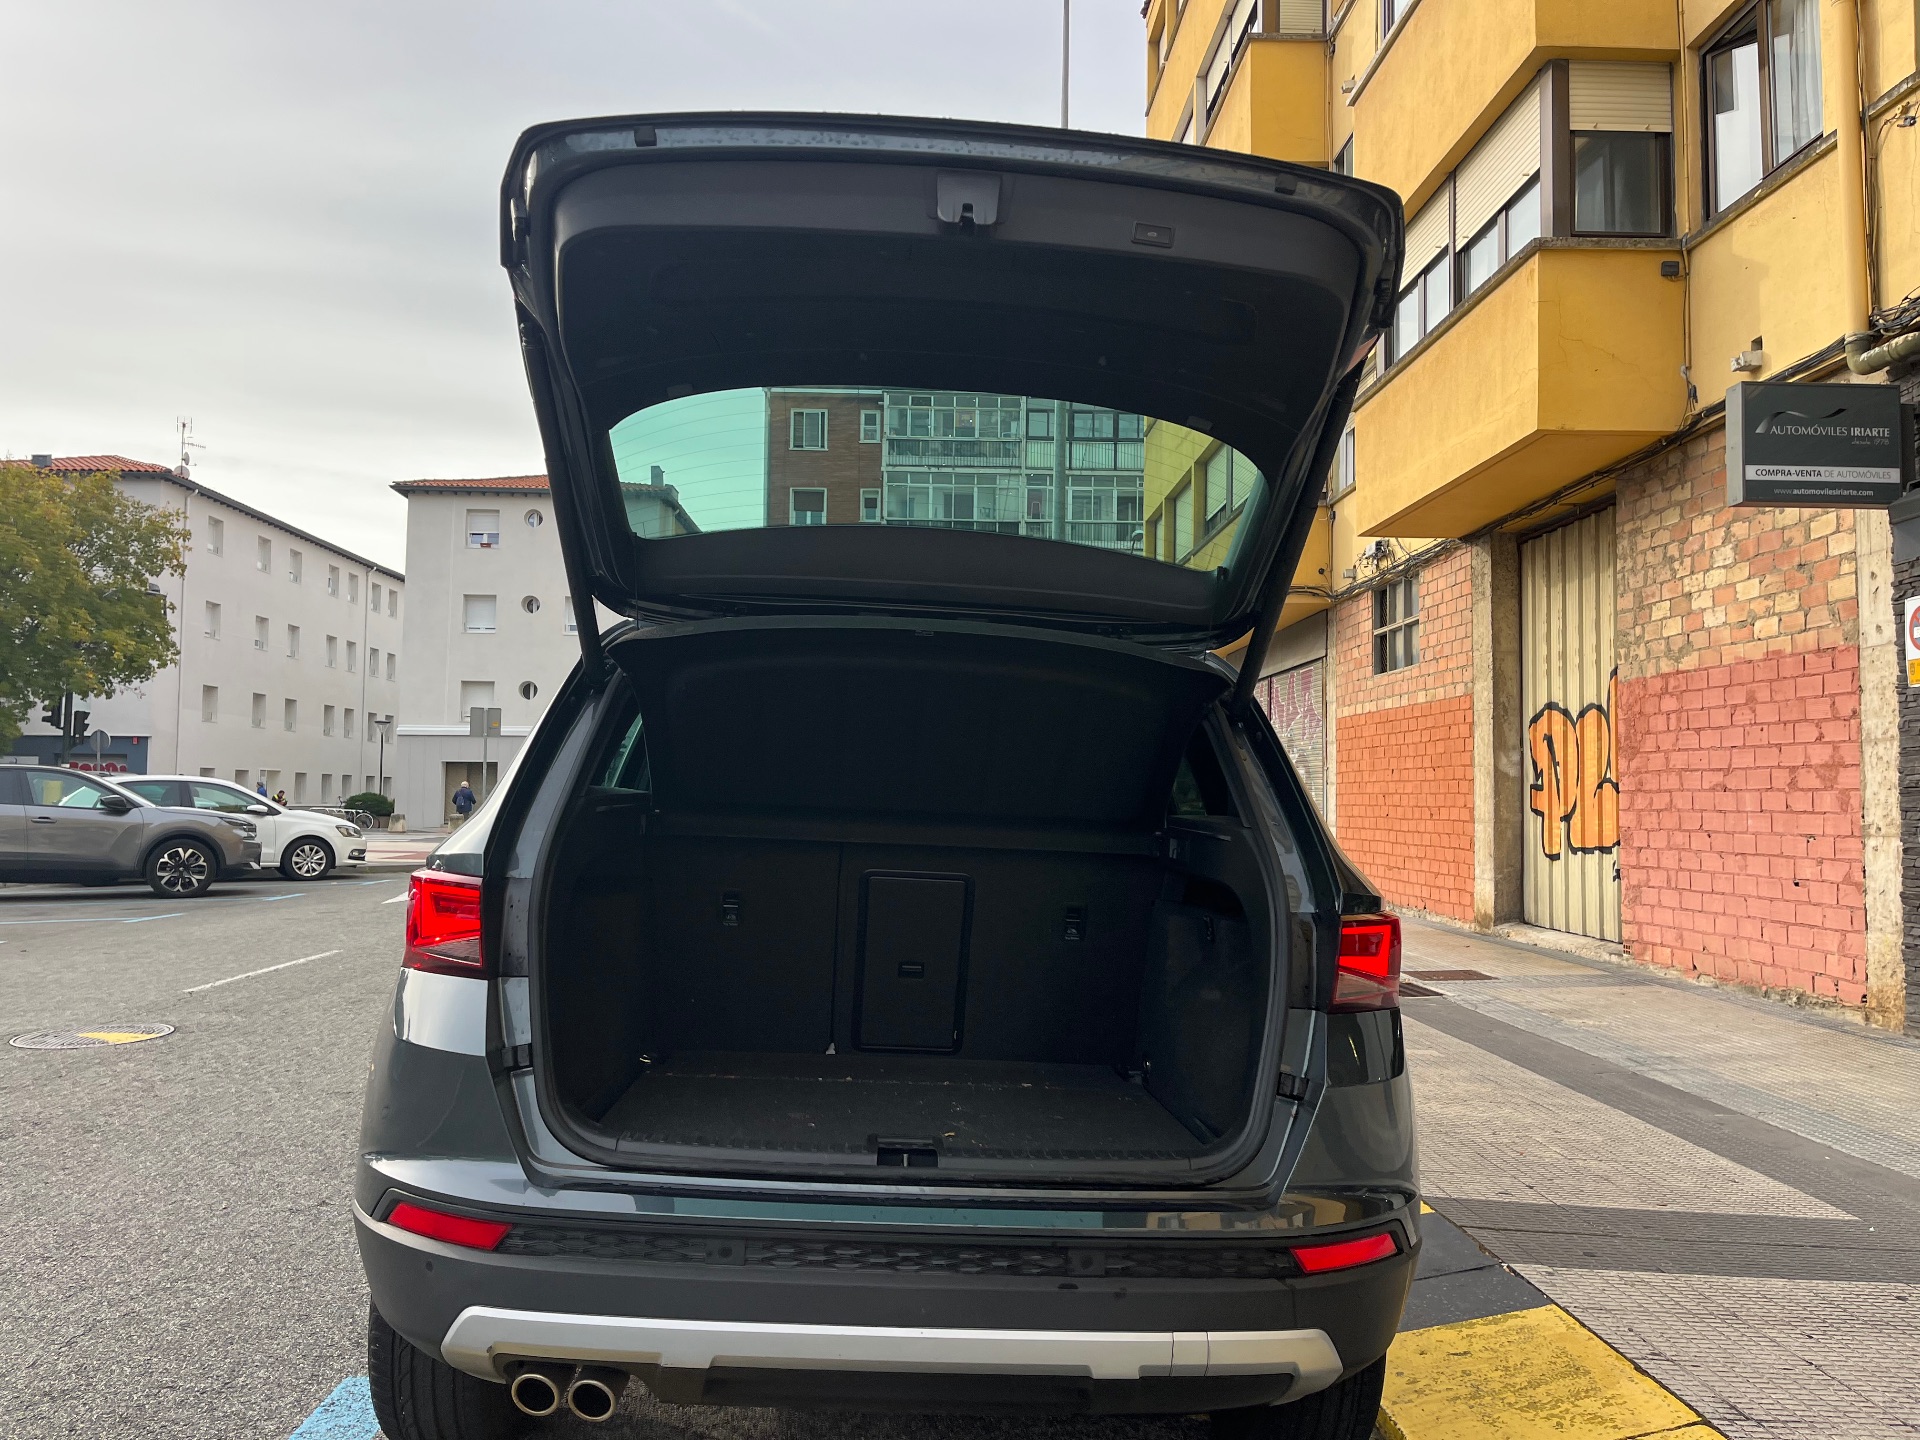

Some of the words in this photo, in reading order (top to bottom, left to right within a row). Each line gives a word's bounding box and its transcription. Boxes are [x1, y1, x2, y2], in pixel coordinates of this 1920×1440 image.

[1770, 424, 1848, 436] AUTOMÓVILES
[1850, 427, 1890, 437] IRIARTE
[1755, 468, 1822, 478] COMPRA-VENTA
[1824, 470, 1834, 478] DE
[1836, 469, 1891, 480] AUTOMÓVILES
[1773, 487, 1874, 497] www.automovilesiriarte.com
